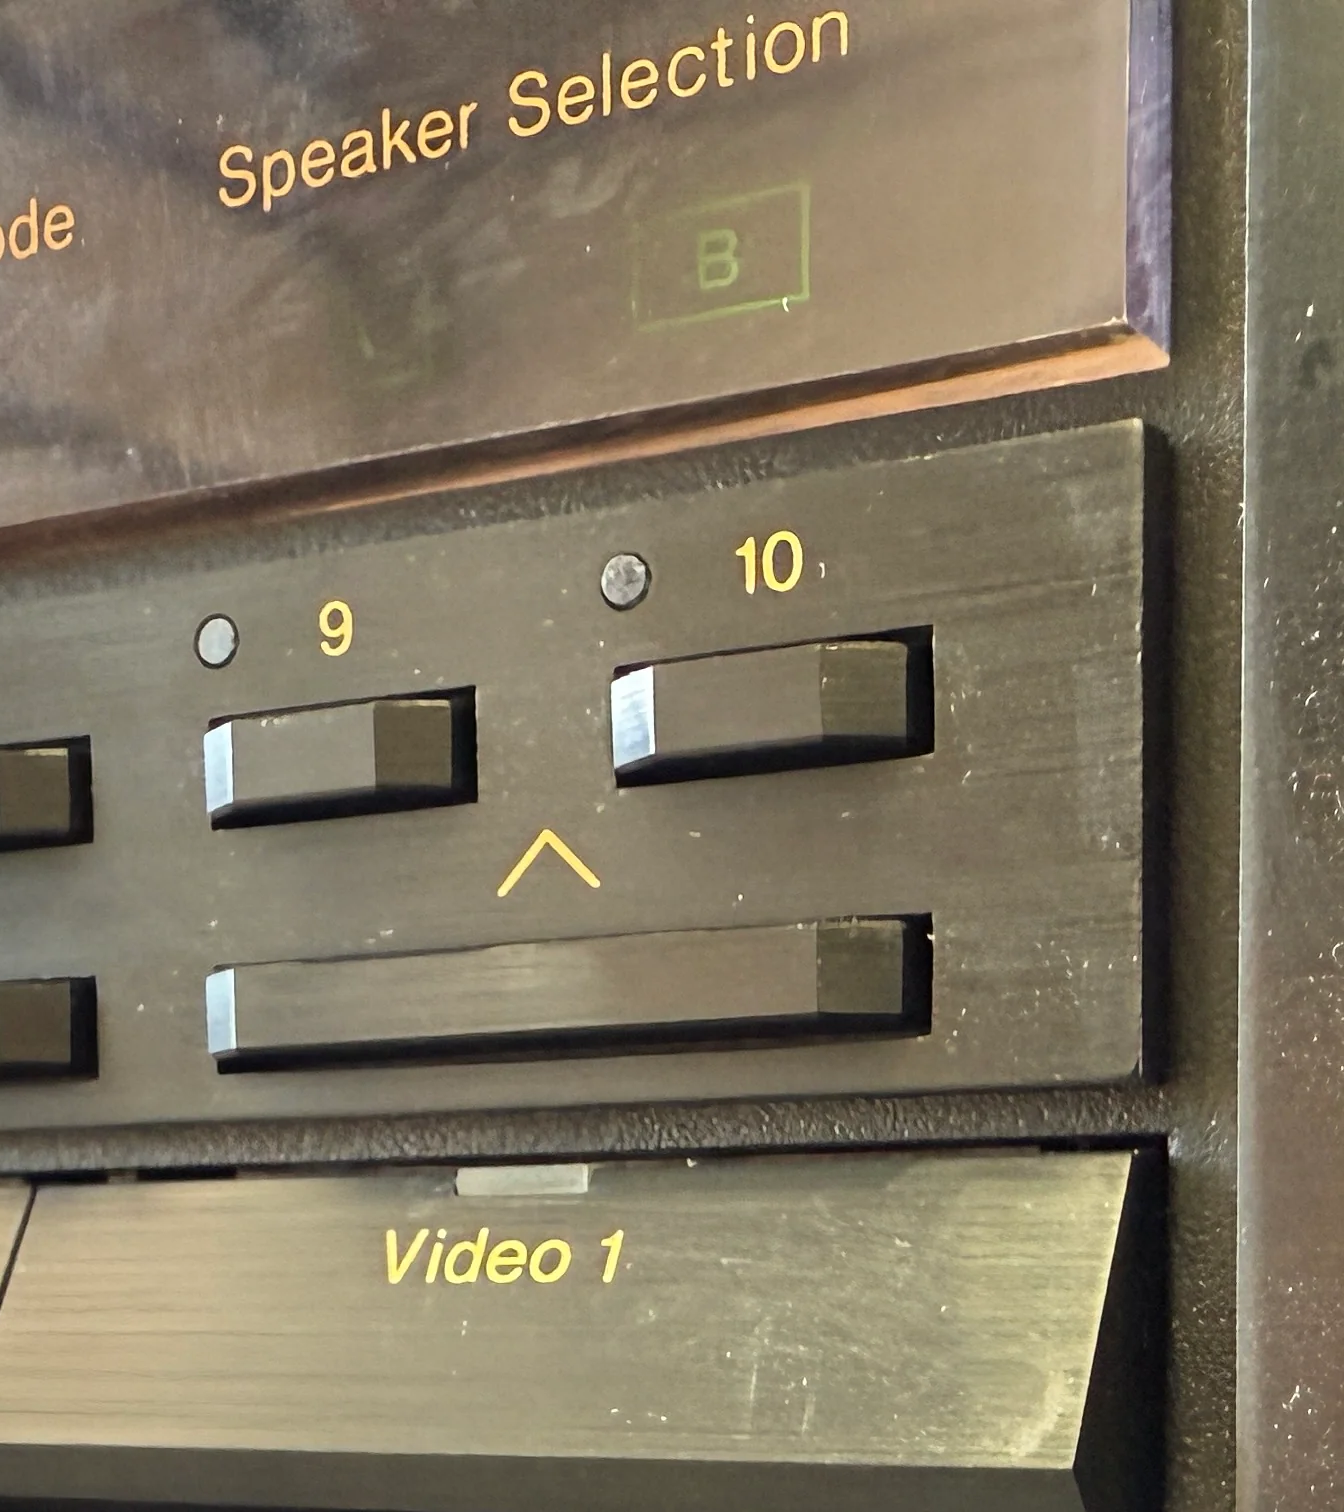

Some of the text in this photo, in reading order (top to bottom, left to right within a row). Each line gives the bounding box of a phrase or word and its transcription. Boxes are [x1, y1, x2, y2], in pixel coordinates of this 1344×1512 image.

[218, 8, 849, 212] Speaker Selection
[697, 226, 741, 290] B
[734, 529, 805, 595] 10
[317, 599, 355, 657] 9
[385, 1227, 626, 1285] Video 1
